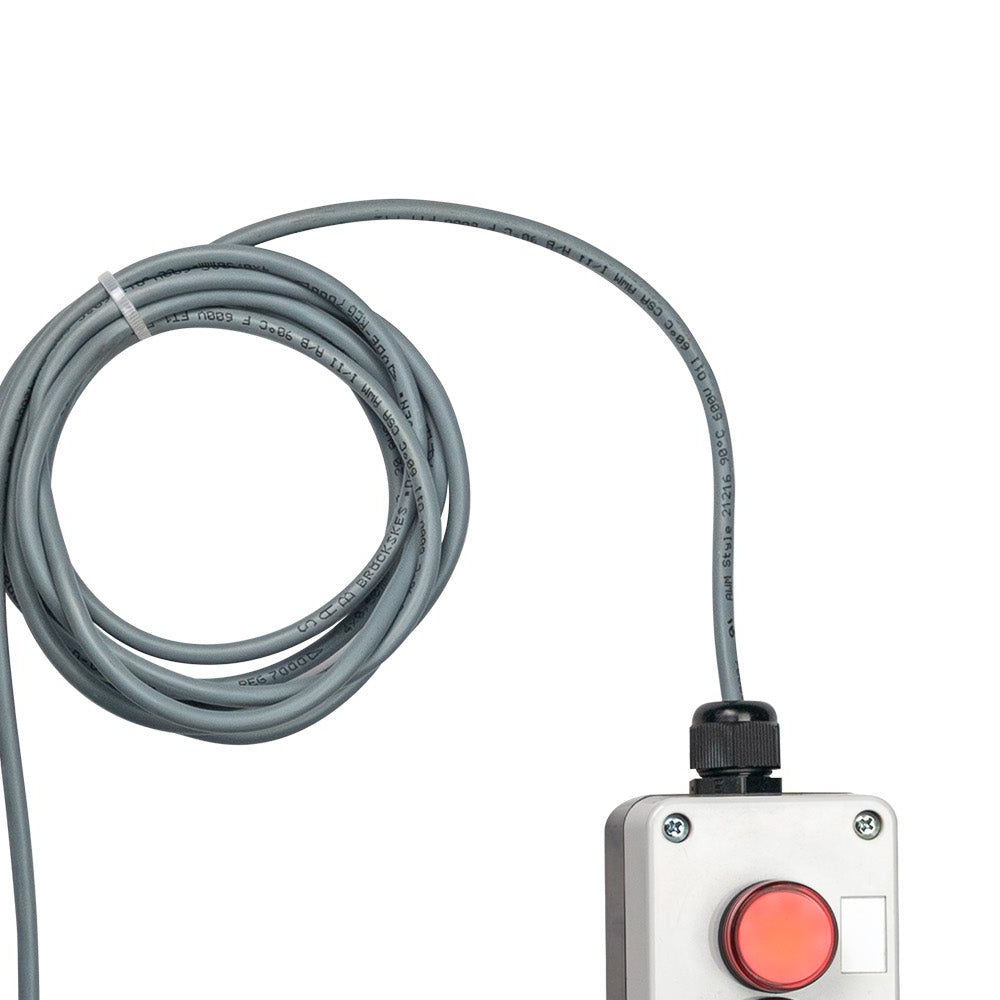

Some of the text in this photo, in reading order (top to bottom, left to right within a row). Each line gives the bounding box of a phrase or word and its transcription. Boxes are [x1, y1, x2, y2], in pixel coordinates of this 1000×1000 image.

[613, 272, 637, 295] AWM
[639, 294, 663, 317] CSA
[242, 315, 252, 326] F
[258, 319, 294, 342] 90°C
[300, 337, 325, 358] A/B
[664, 319, 690, 351] 60°C
[361, 383, 382, 408] AWM
[382, 409, 400, 437] CSA
[399, 441, 418, 478] 60°C
[715, 429, 730, 467] 90°C
[722, 474, 732, 517] 21216
[722, 525, 732, 568] Style
[724, 575, 733, 601] AWM
